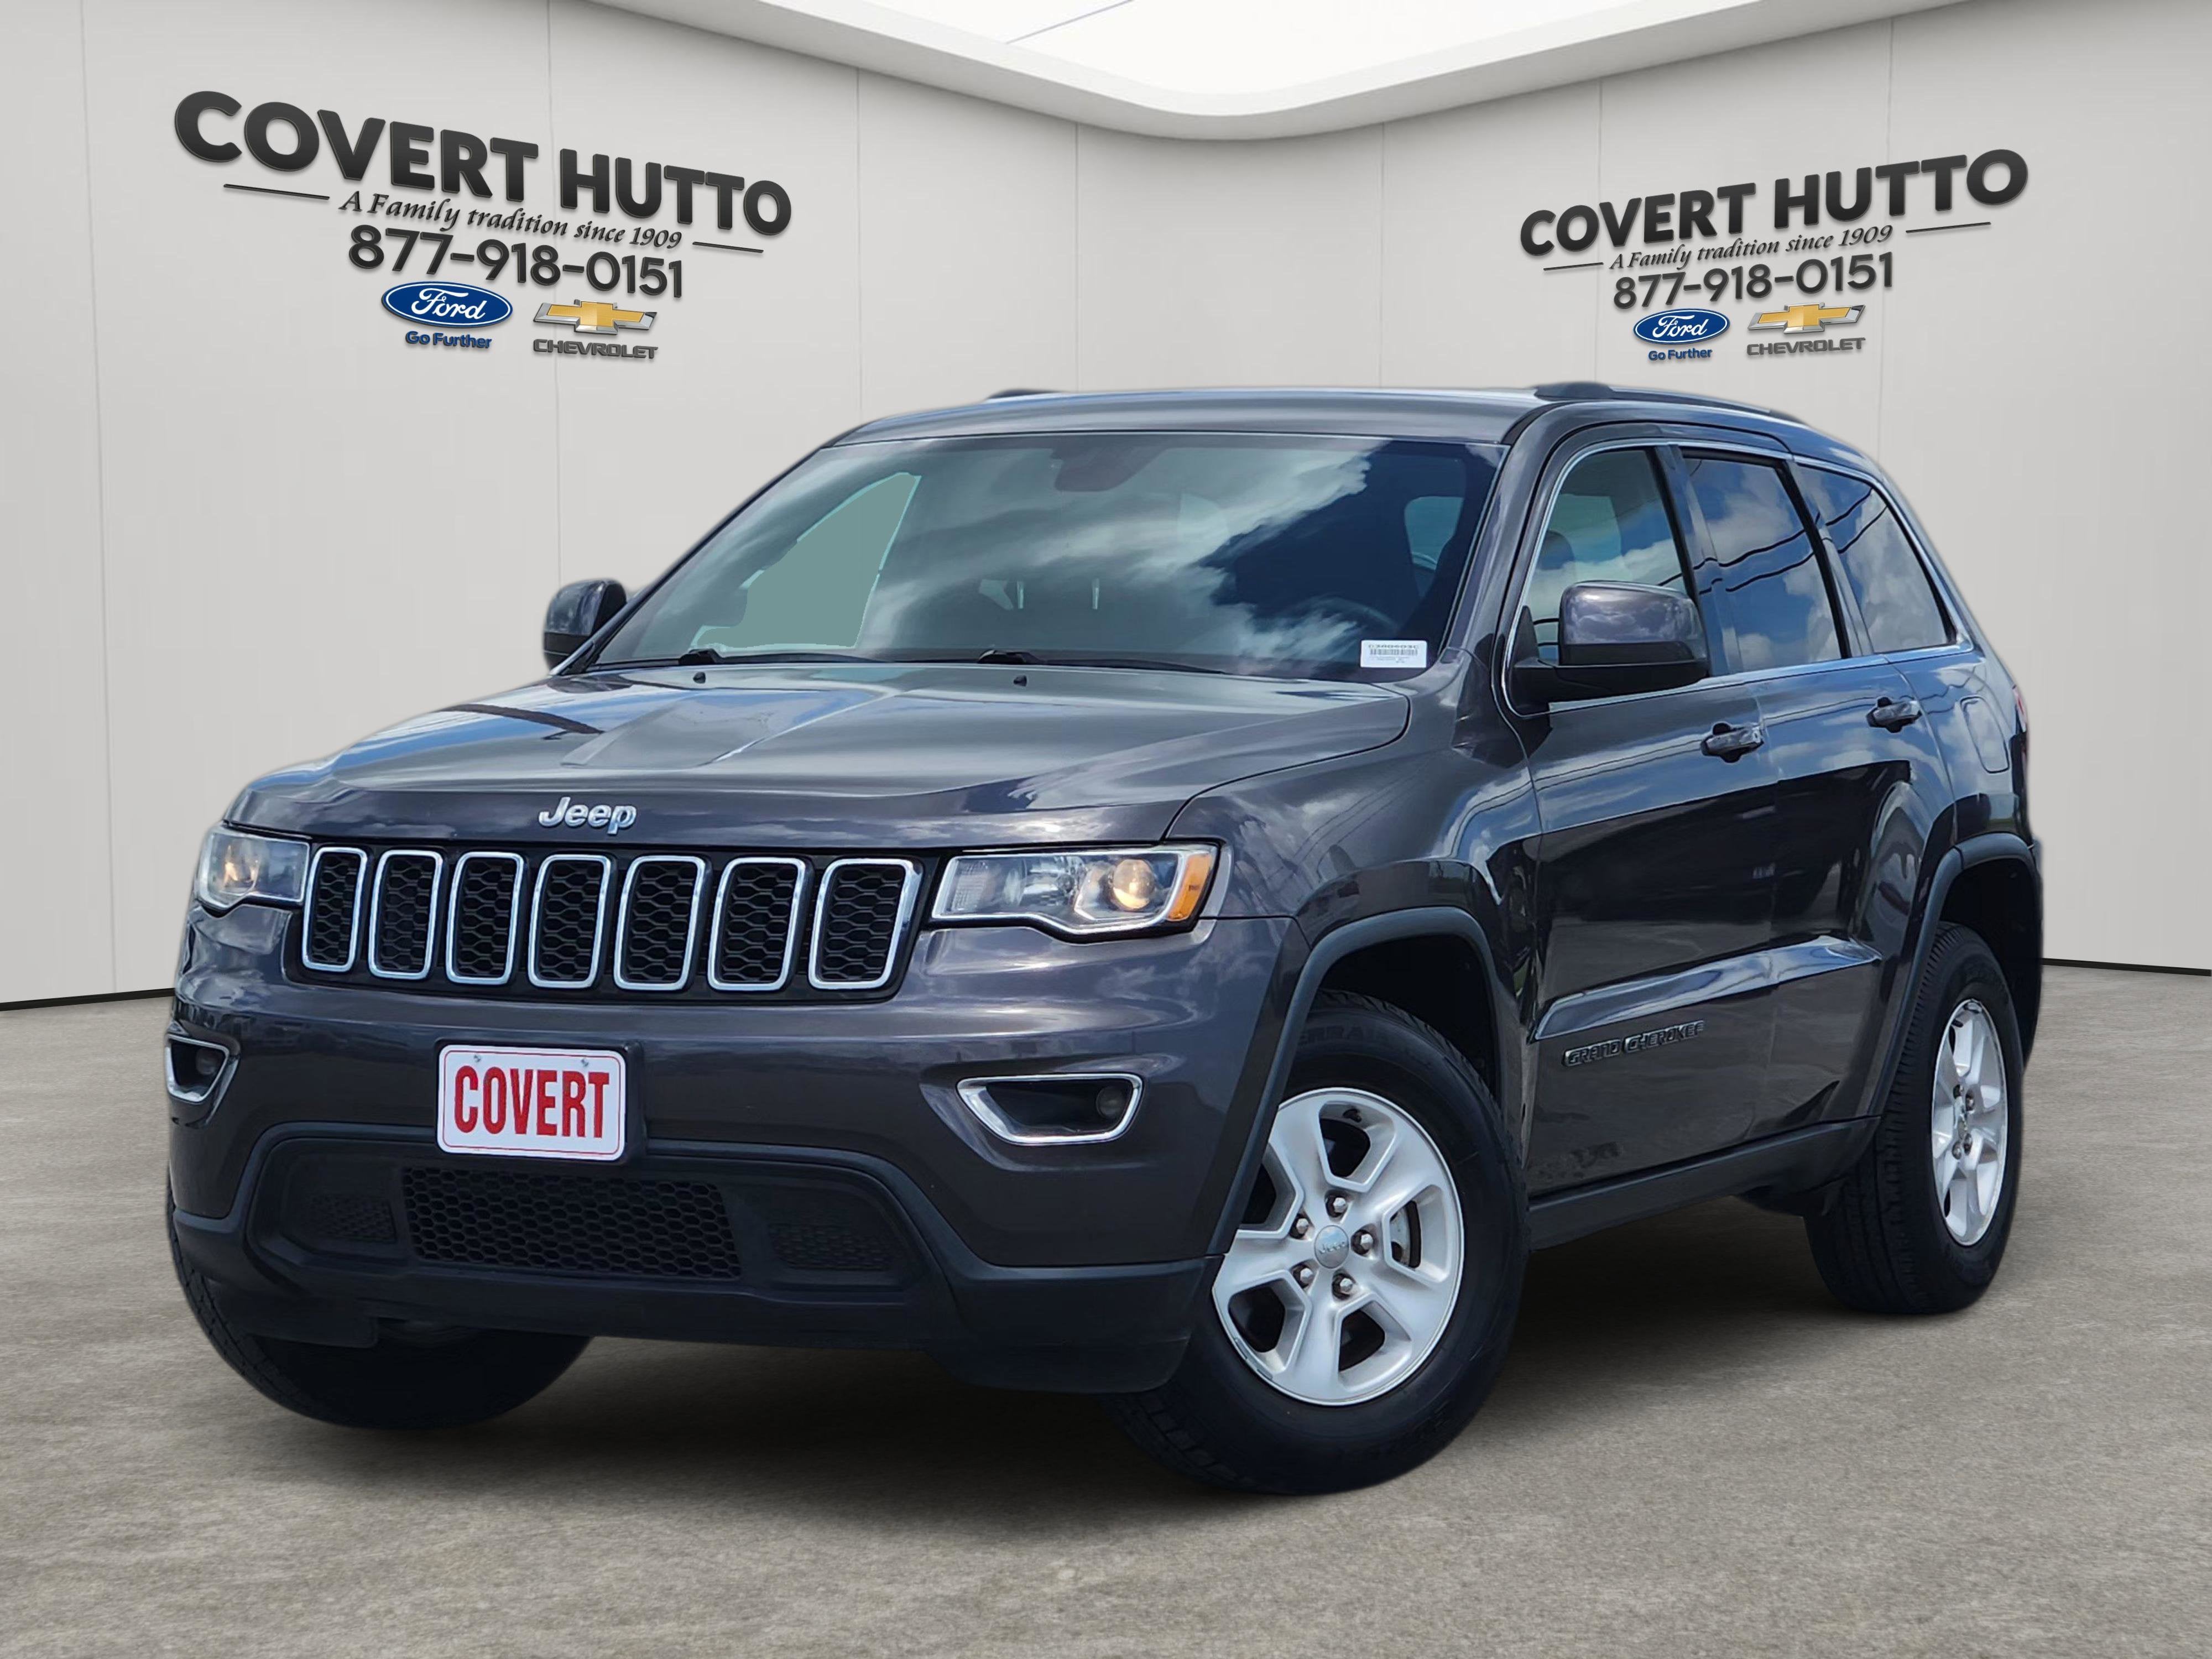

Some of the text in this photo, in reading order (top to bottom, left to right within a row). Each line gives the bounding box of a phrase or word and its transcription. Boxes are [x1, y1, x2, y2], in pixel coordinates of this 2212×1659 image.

[175, 91, 791, 235] COVERT HUTTO
[338, 191, 683, 249] A Family tradition since 1909
[1520, 149, 2028, 255] COVERT HUTTO
[348, 225, 682, 298] 877-918-0151
[1609, 225, 1893, 270] A Family tradition since 1909
[1613, 252, 1893, 309] 877-918-0151
[411, 288, 487, 324] Ford
[1652, 308, 1708, 337] Ford
[405, 331, 492, 349] Go Further
[533, 339, 659, 359] CHEVROLET
[1648, 348, 1713, 361] Go Further
[1747, 337, 1866, 355] CHEVROLET
[539, 796, 637, 834] Jeep
[455, 1065, 610, 1139] COVERT
